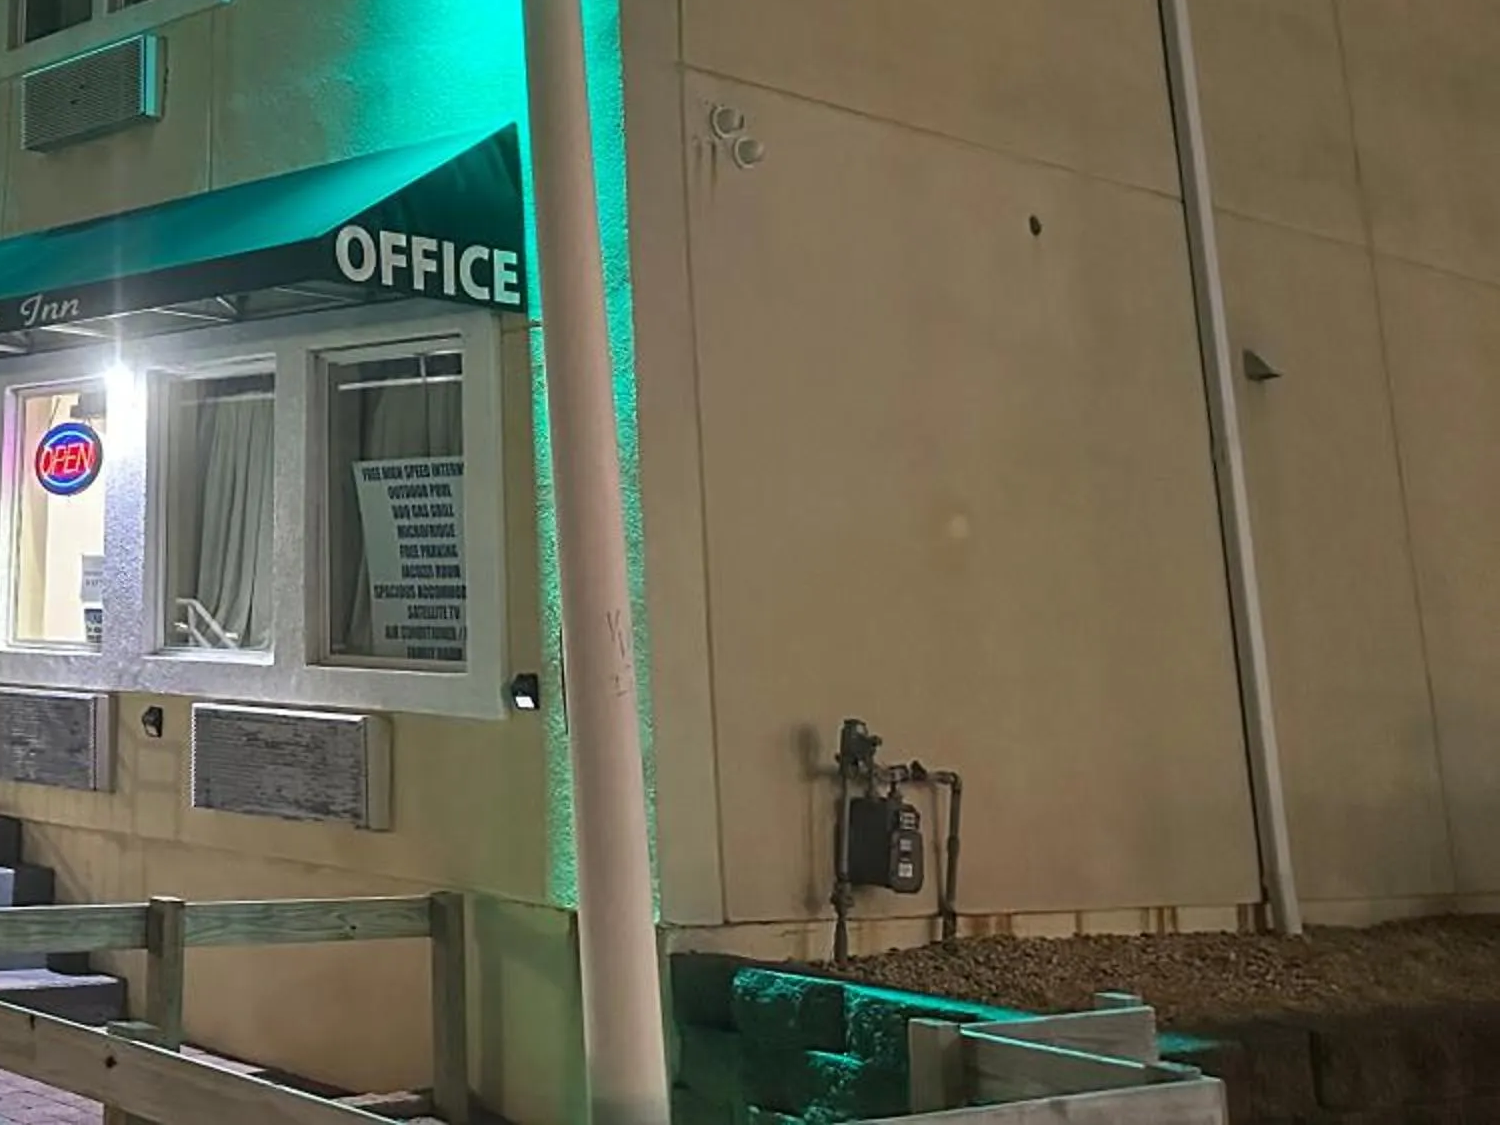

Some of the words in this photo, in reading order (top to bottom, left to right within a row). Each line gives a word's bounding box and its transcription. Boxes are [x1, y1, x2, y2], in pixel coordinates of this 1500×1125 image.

[335, 224, 521, 306] OFFICE
[19, 294, 80, 326] Inn
[40, 441, 97, 478] OPEN
